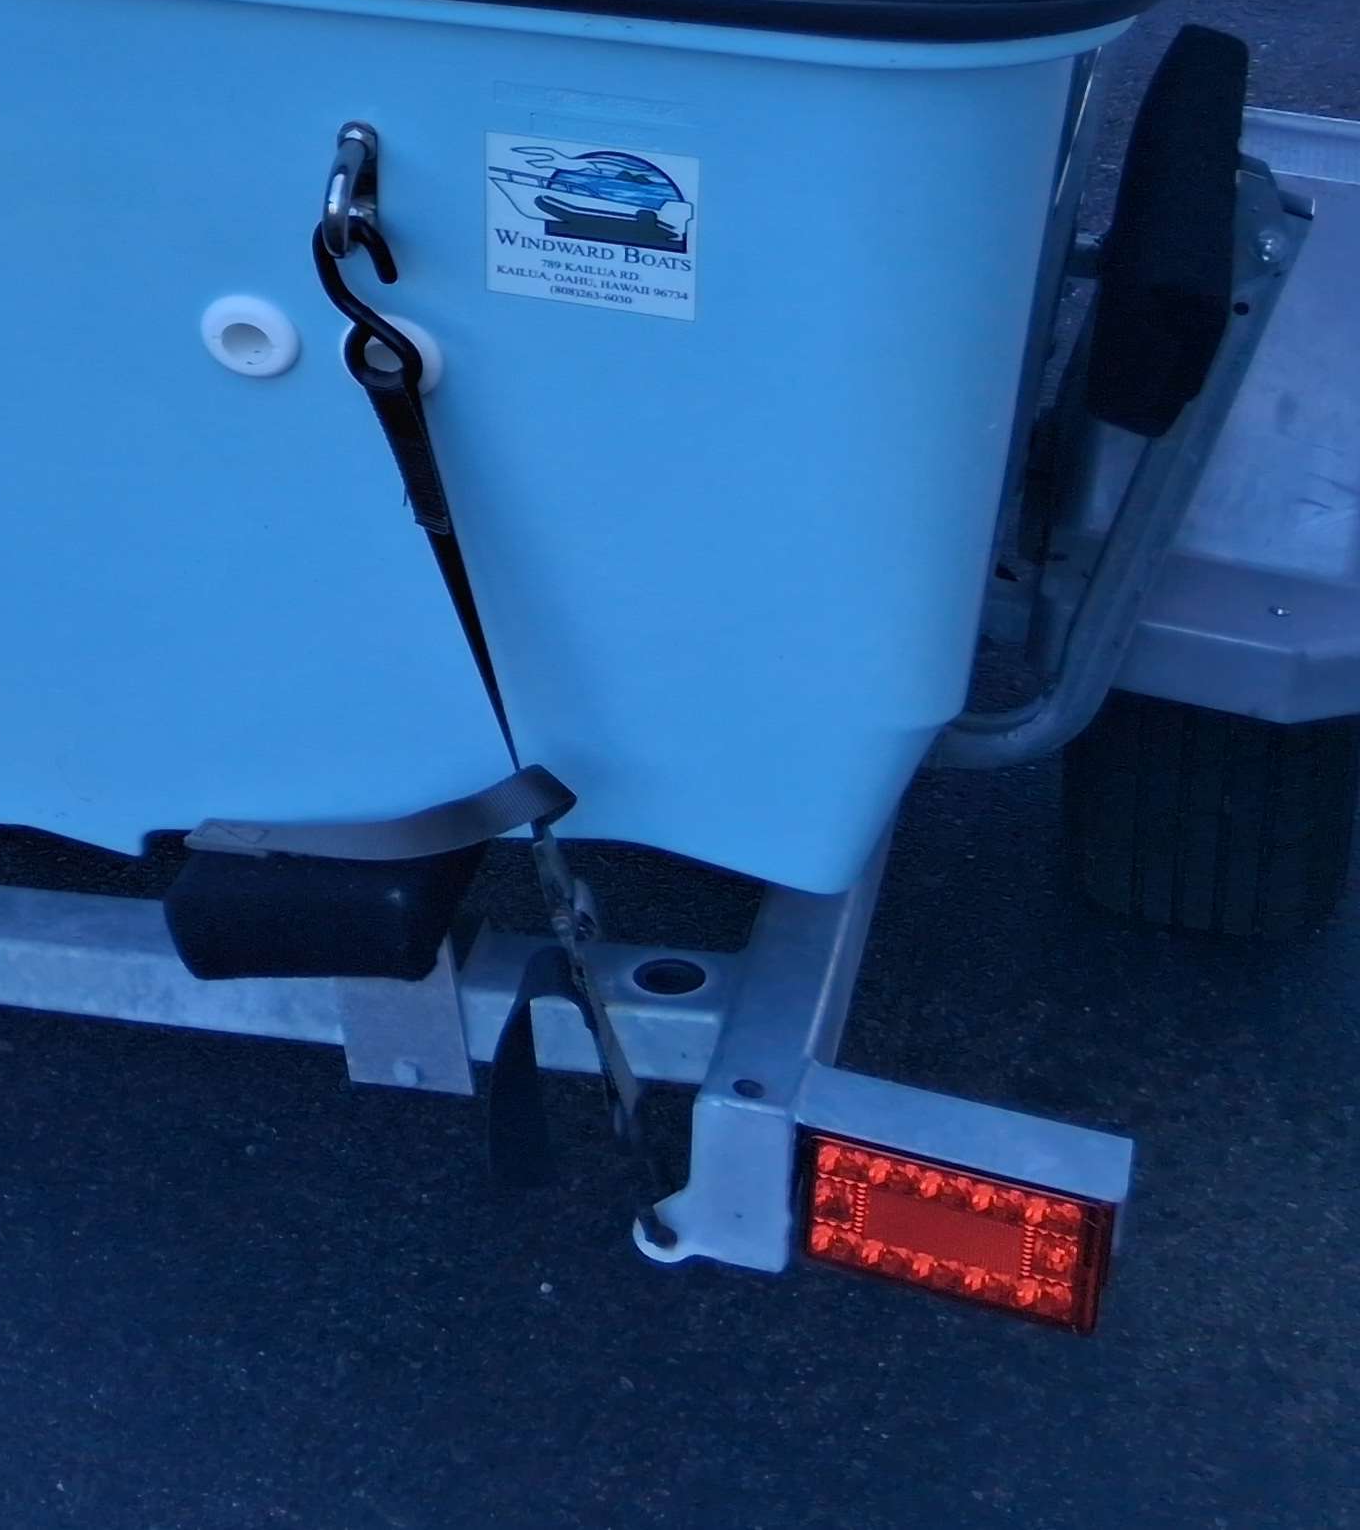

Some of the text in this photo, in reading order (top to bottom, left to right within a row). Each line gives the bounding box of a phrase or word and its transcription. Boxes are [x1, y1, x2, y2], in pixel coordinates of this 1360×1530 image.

[541, 259, 561, 270] 789
[564, 262, 617, 278] KAILUA
[601, 280, 650, 295] HAWAII
[653, 288, 689, 301] 96734
